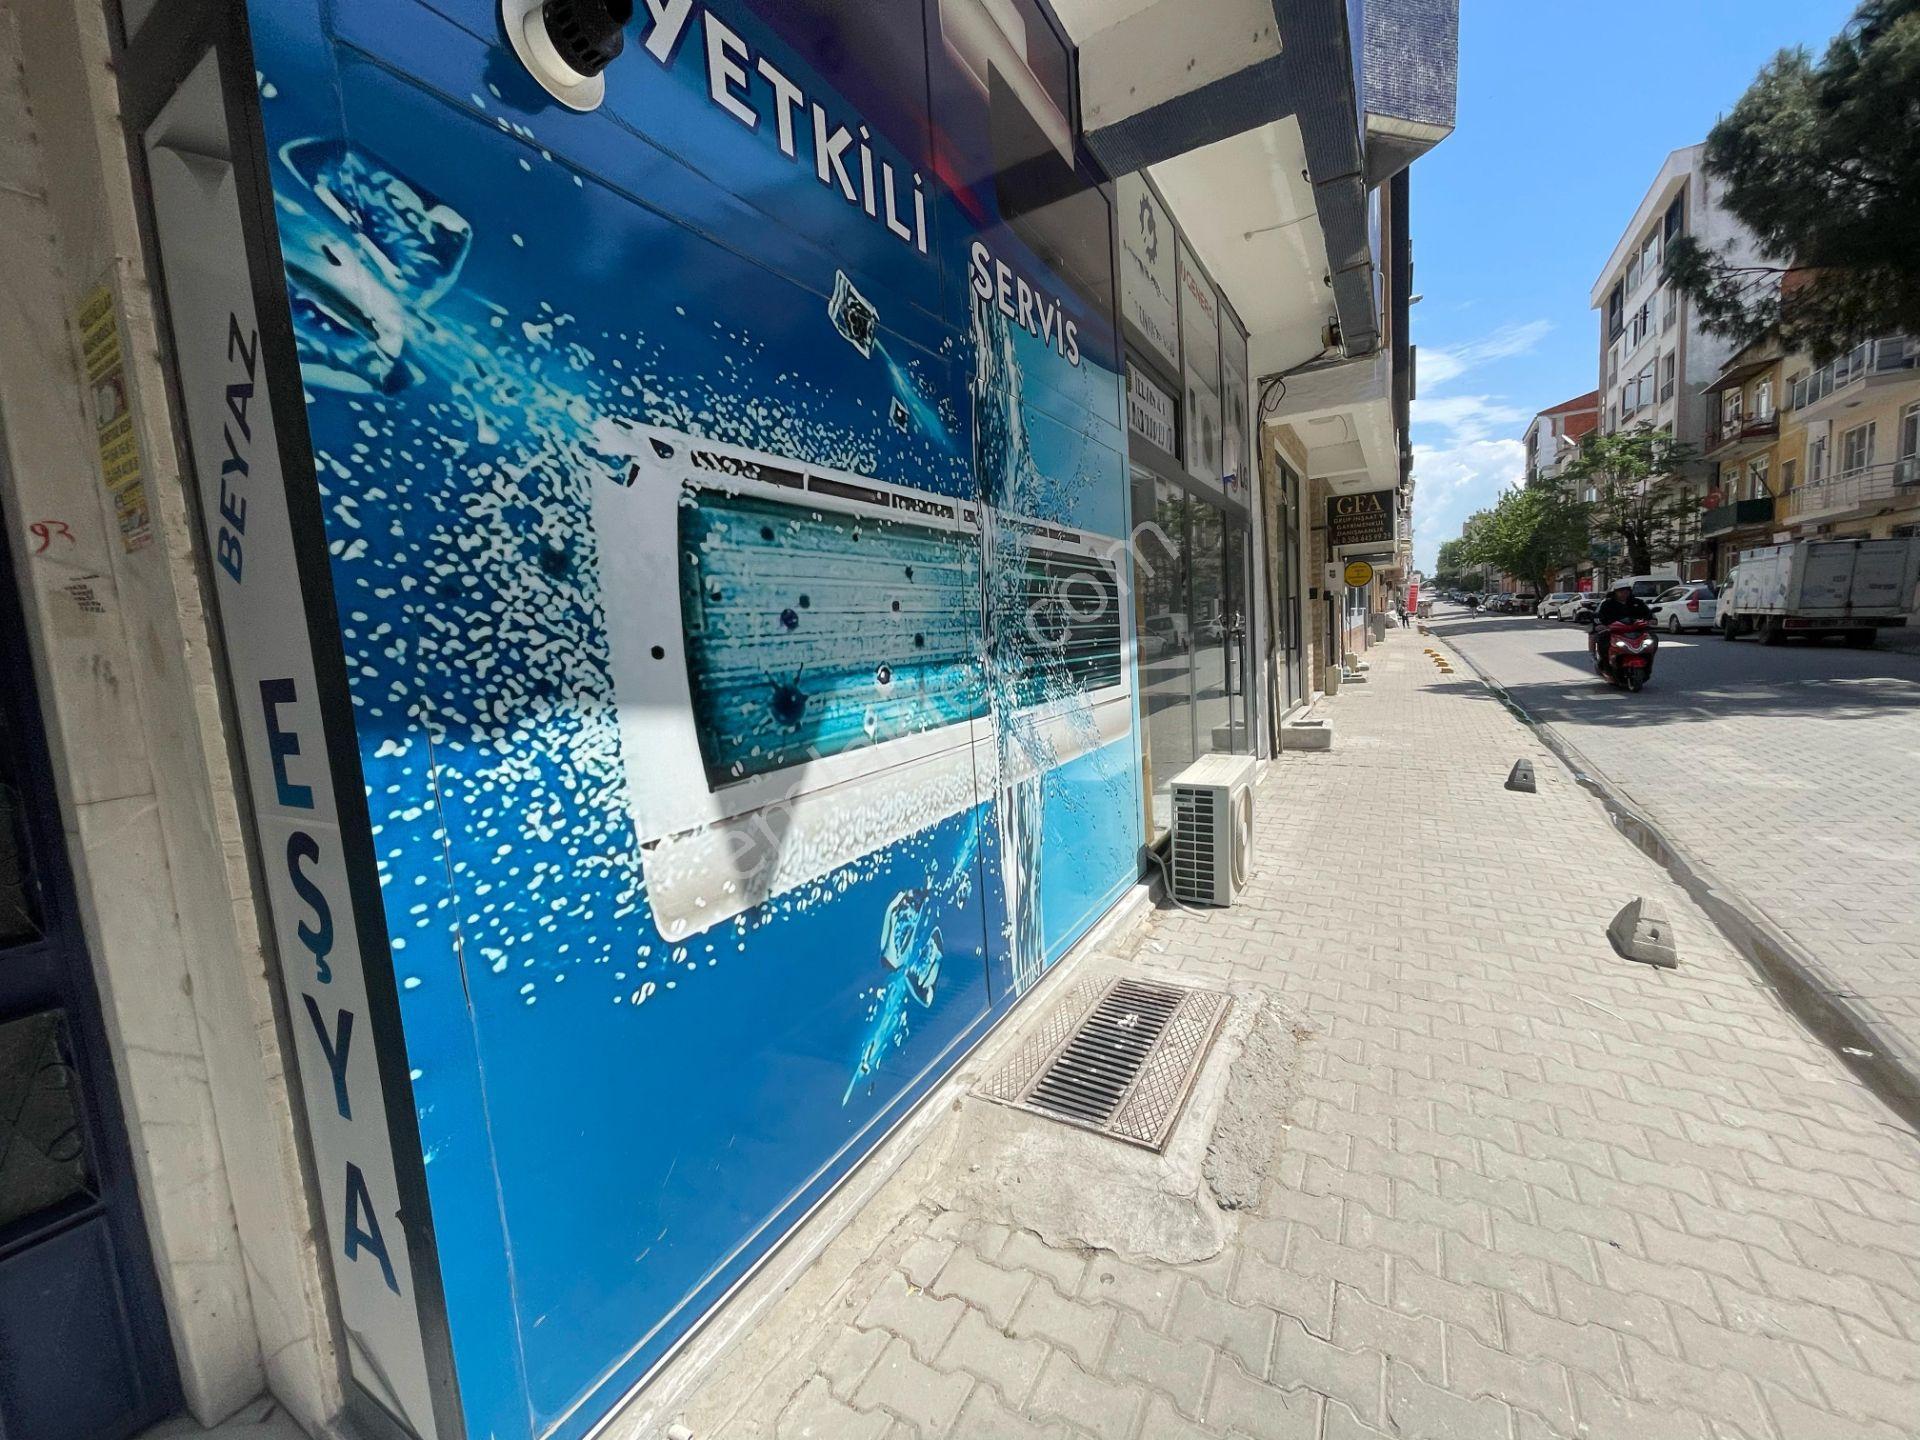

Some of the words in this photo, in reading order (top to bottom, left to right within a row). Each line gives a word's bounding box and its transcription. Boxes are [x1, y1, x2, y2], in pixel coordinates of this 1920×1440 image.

[645, 0, 928, 254] YETKİLİ
[971, 241, 1080, 367] SERVİS
[1336, 494, 1383, 515] GFA
[217, 312, 258, 584] BEYAZ
[259, 678, 401, 1297] EŞYA
